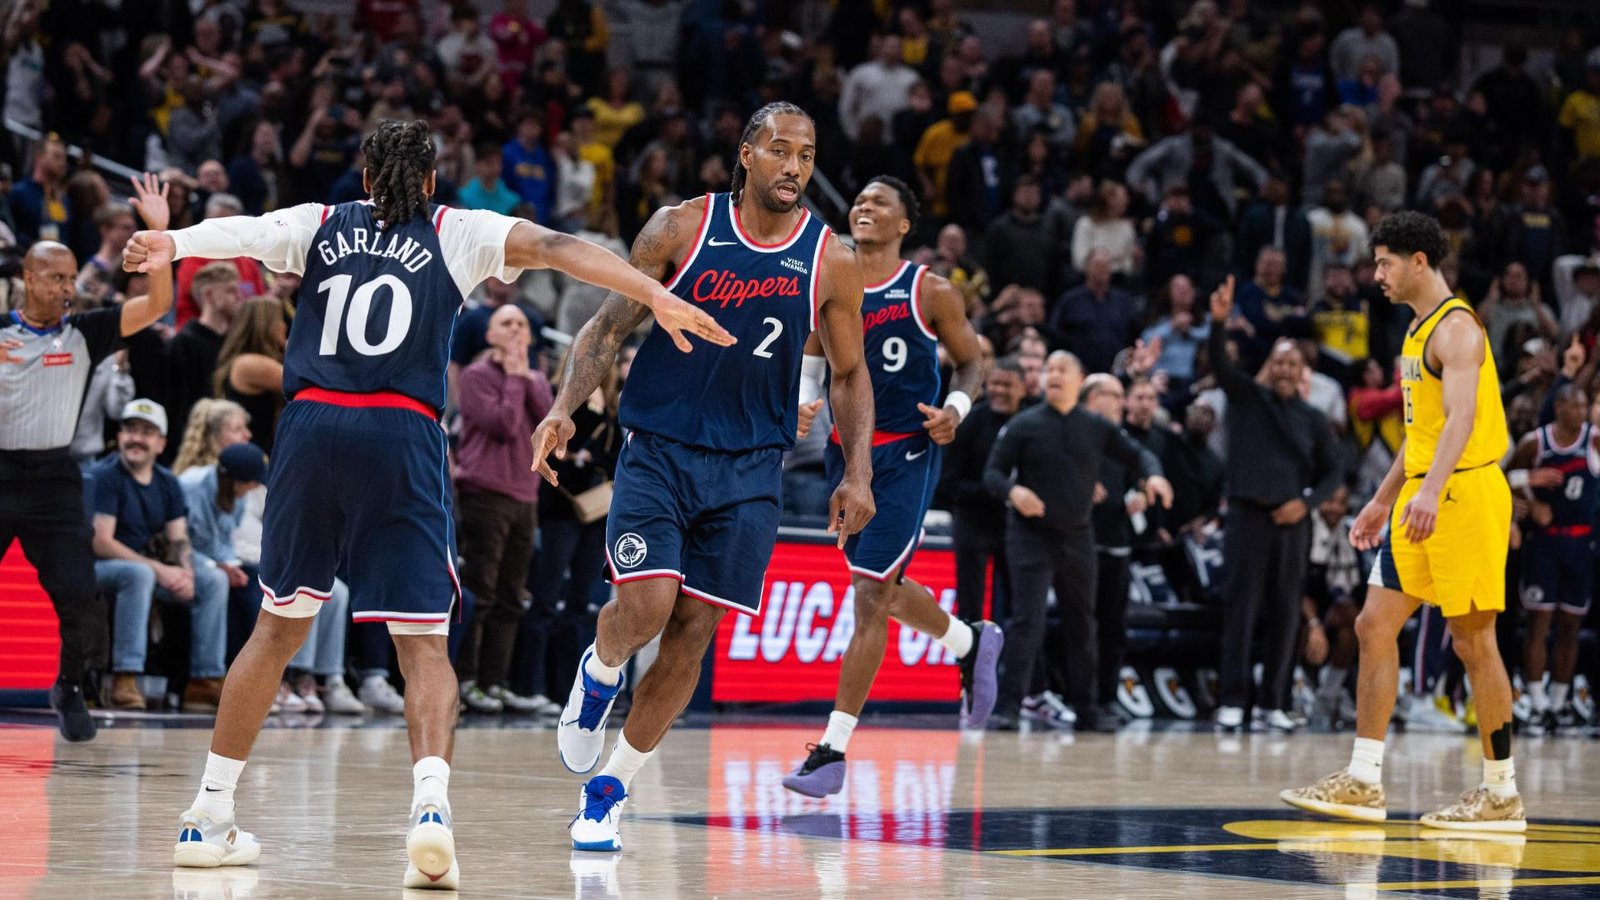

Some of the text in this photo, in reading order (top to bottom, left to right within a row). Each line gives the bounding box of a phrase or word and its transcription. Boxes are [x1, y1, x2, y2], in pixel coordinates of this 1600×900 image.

[318, 227, 433, 273] GARLAND
[693, 269, 801, 308] Clippers
[317, 273, 413, 356] 10
[863, 302, 910, 334] pers
[752, 316, 784, 359] 2
[882, 336, 908, 373] 9
[728, 581, 856, 663] LUCA
